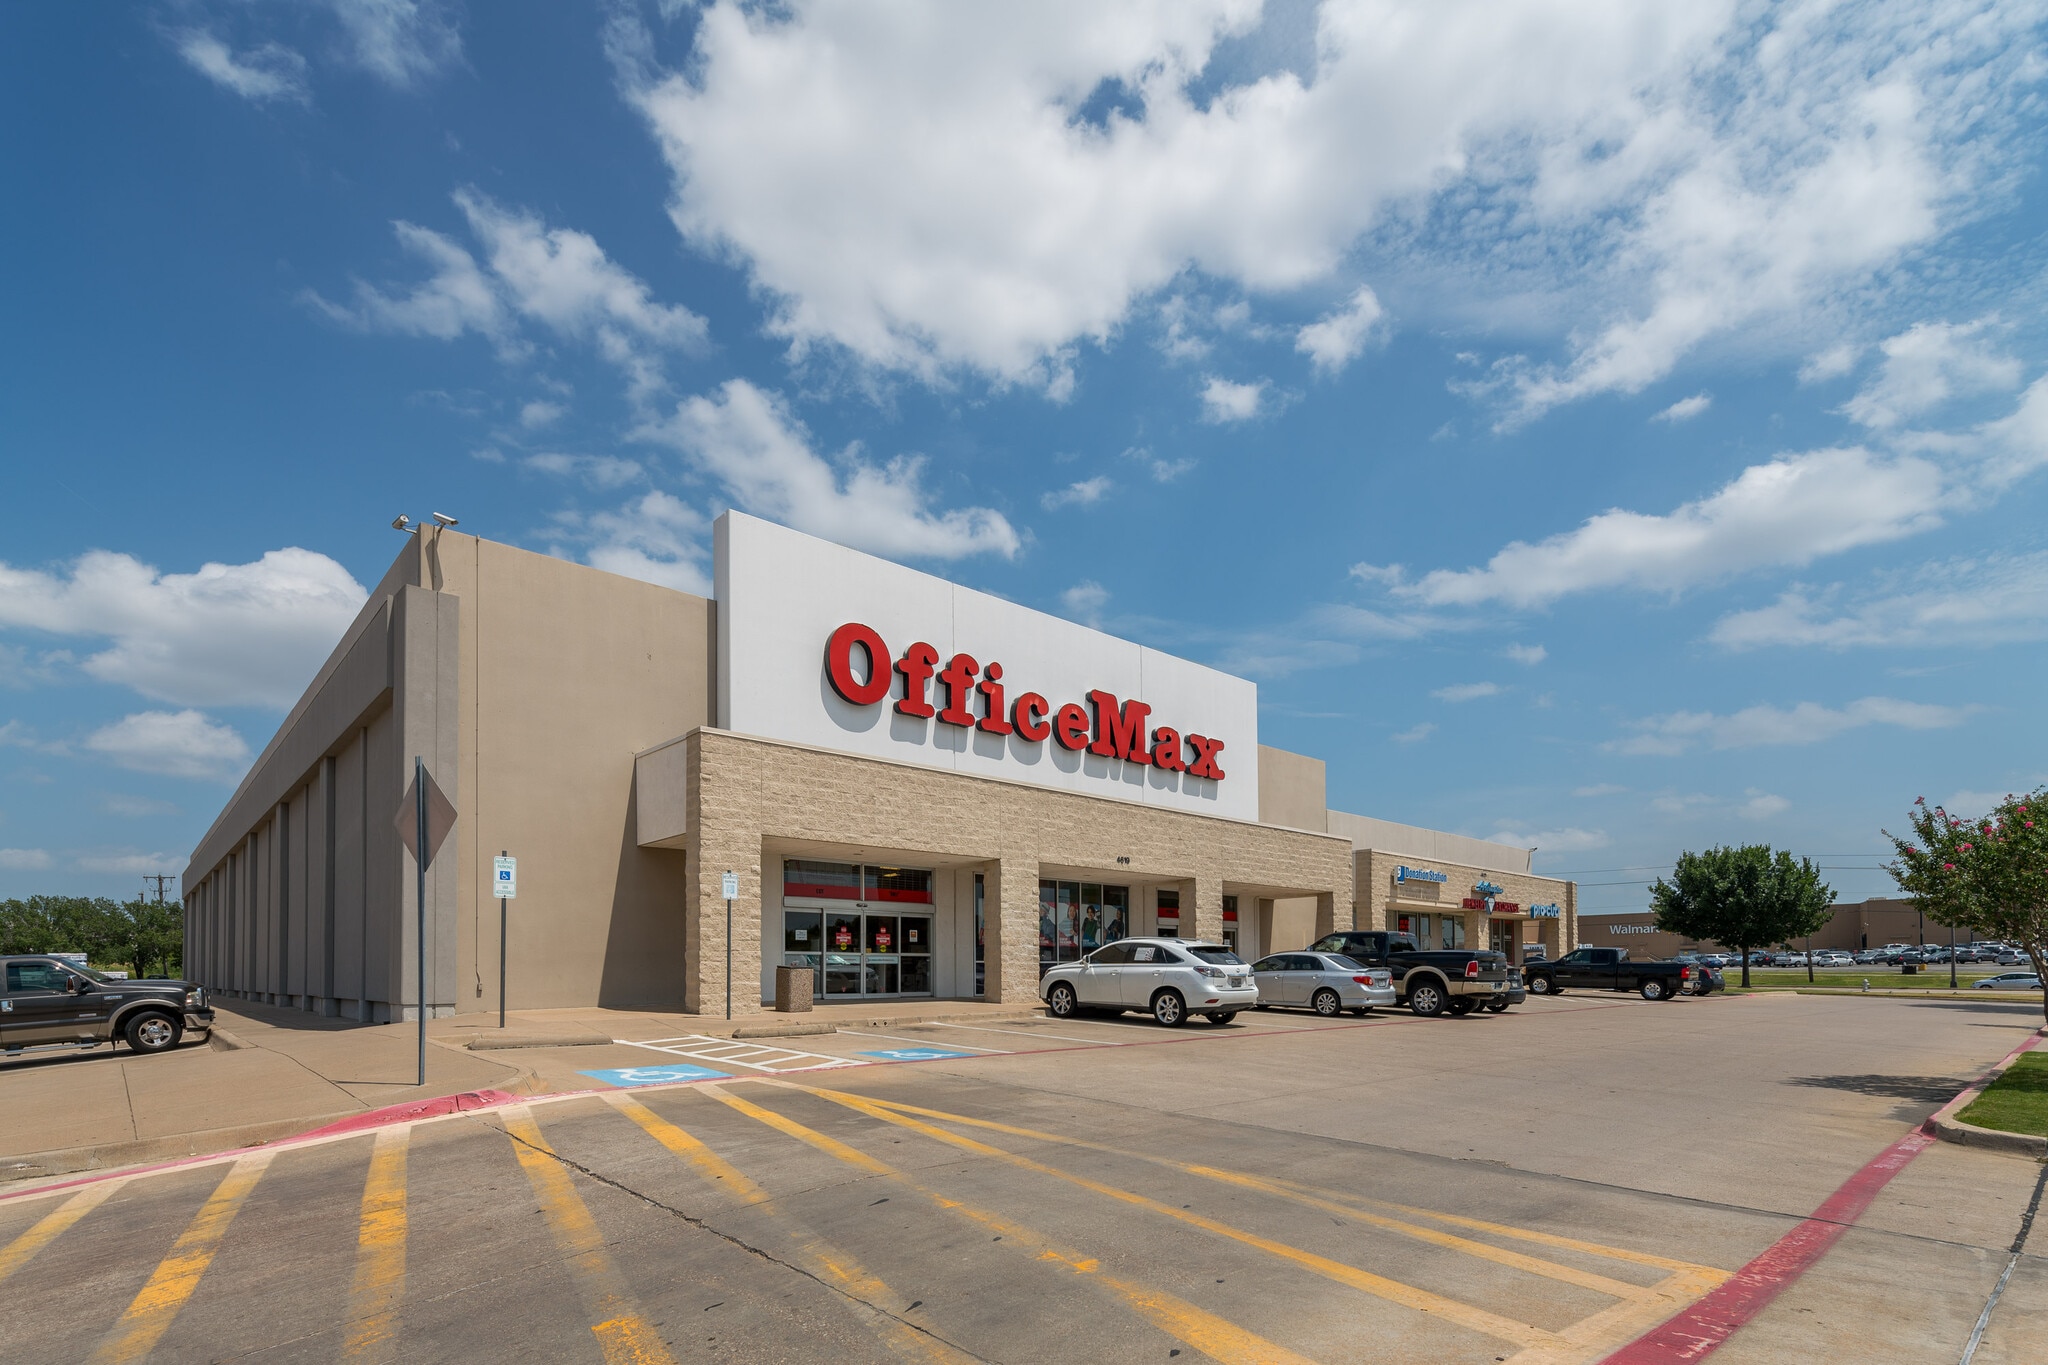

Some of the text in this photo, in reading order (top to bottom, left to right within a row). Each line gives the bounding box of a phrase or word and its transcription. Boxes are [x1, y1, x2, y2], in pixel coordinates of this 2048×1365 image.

[825, 623, 1225, 780] OfficeMax
[1405, 866, 1447, 882] Donation Station
